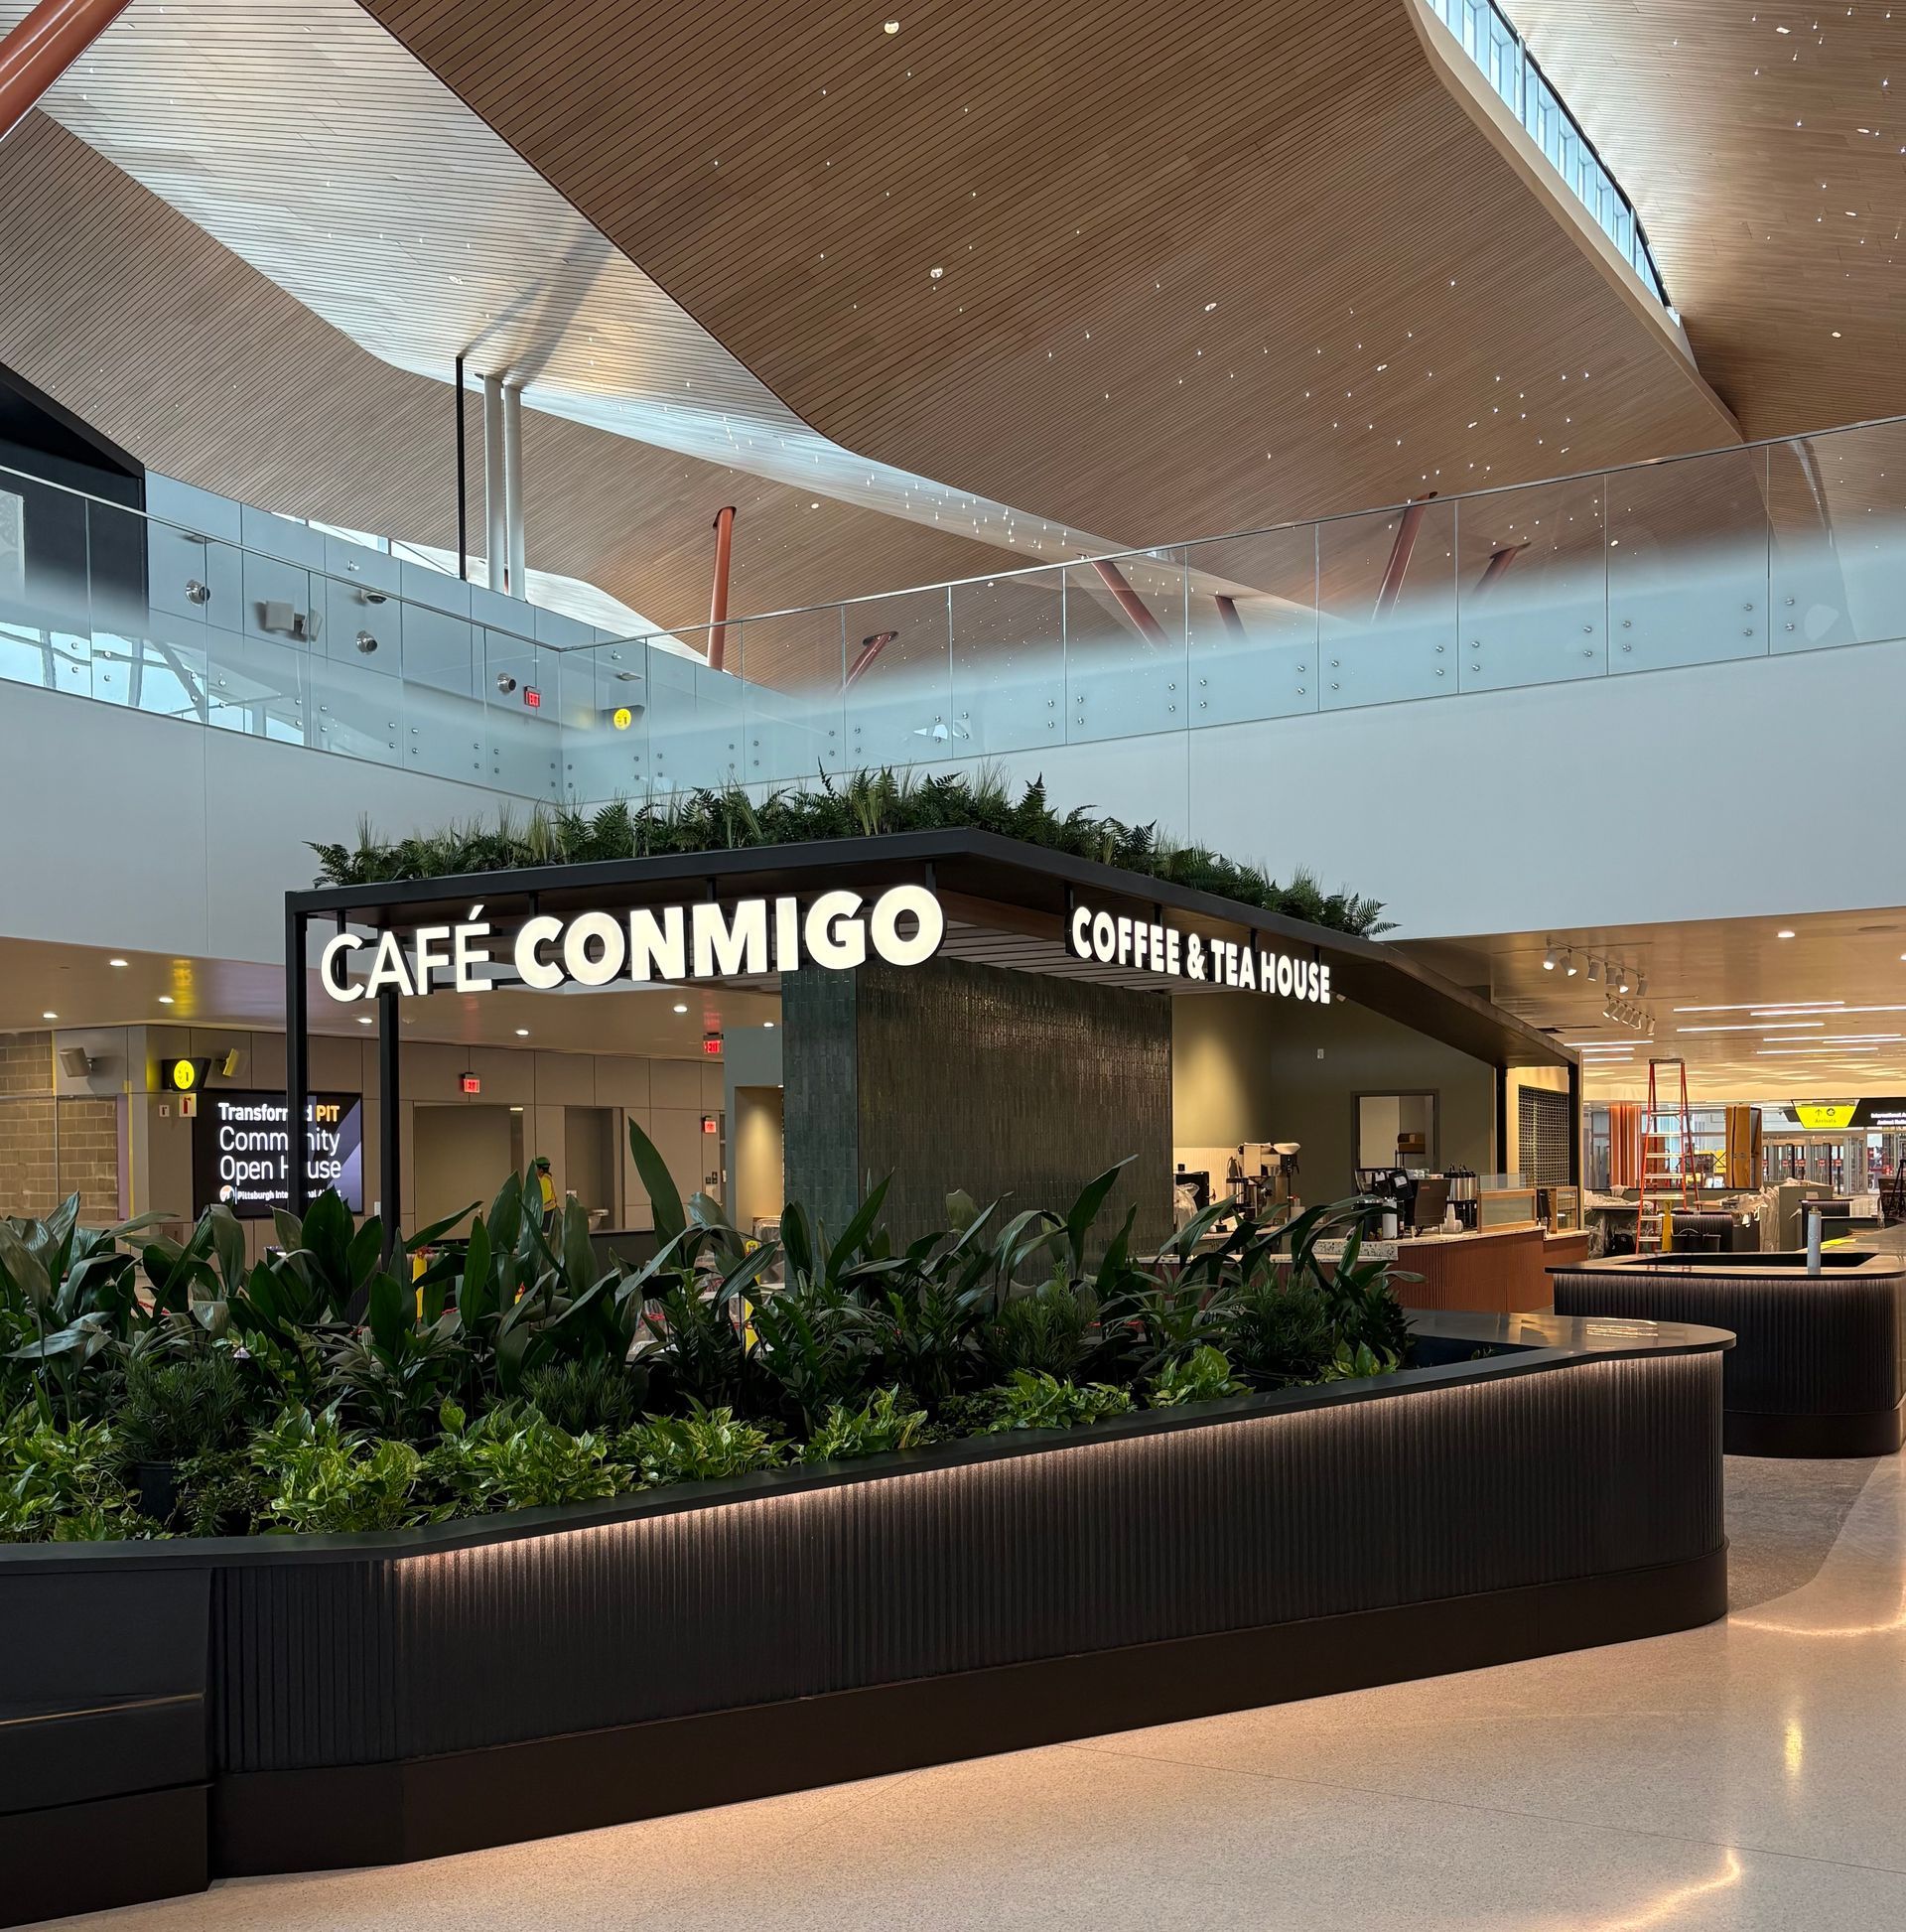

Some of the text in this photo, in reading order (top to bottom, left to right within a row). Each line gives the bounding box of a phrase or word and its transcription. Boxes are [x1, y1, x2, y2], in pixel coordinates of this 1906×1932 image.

[320, 885, 945, 1003] CAFÉ CONMIGO
[1071, 905, 1331, 1005] COFFEE & TEA HOUSE
[217, 1102, 340, 1123] Transford PIT
[219, 1125, 340, 1157] Commnity
[219, 1155, 341, 1186] Open Huse
[237, 1189, 275, 1201] Pittsburgh
